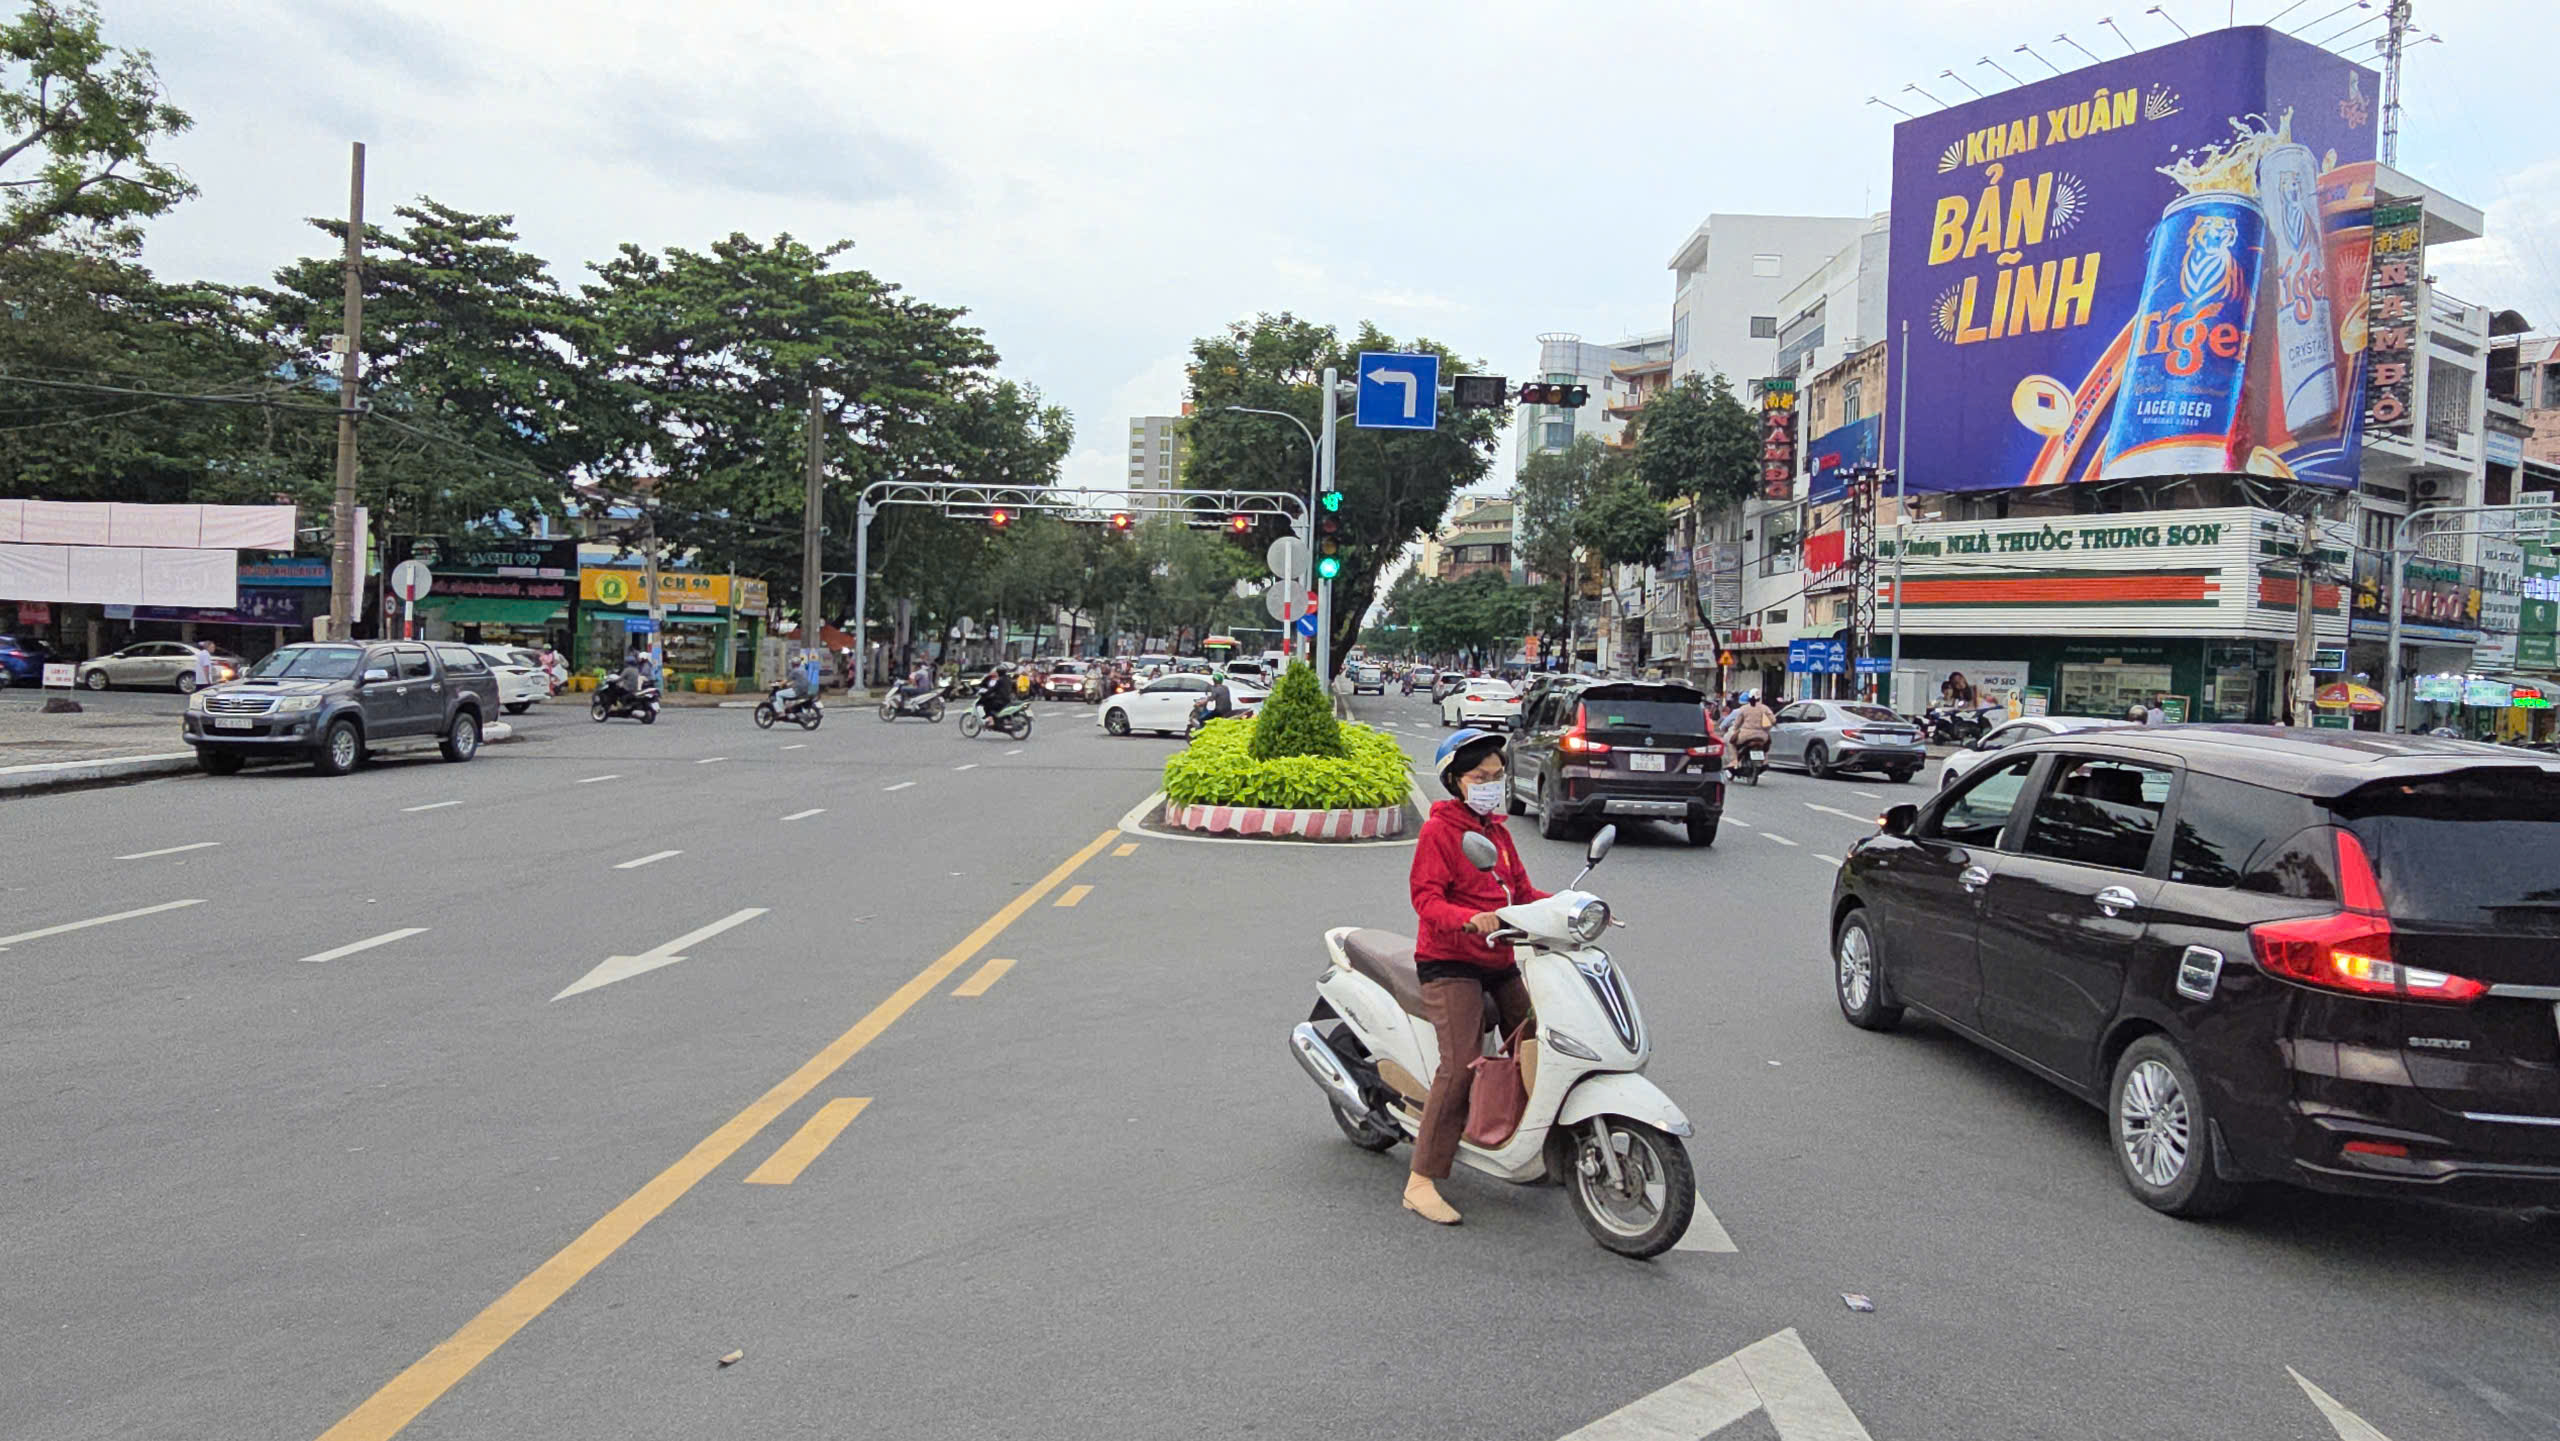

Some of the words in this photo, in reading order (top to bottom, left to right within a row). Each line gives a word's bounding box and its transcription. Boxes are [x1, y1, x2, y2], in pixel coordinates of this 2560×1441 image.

[1966, 115, 2039, 167] KHAI
[2046, 88, 2138, 146] XUÂN
[1928, 163, 2053, 265] BẢN
[1955, 250, 2101, 345] LĨNH
[2137, 400, 2177, 416] LAGER
[2179, 400, 2212, 418] BEER
[1946, 529, 1991, 553] NHÀ
[1997, 523, 2073, 551] THUỐC
[2079, 526, 2160, 549] TRUNG
[692, 578, 711, 589] 99
[2408, 1036, 2471, 1050] SUZUKI
